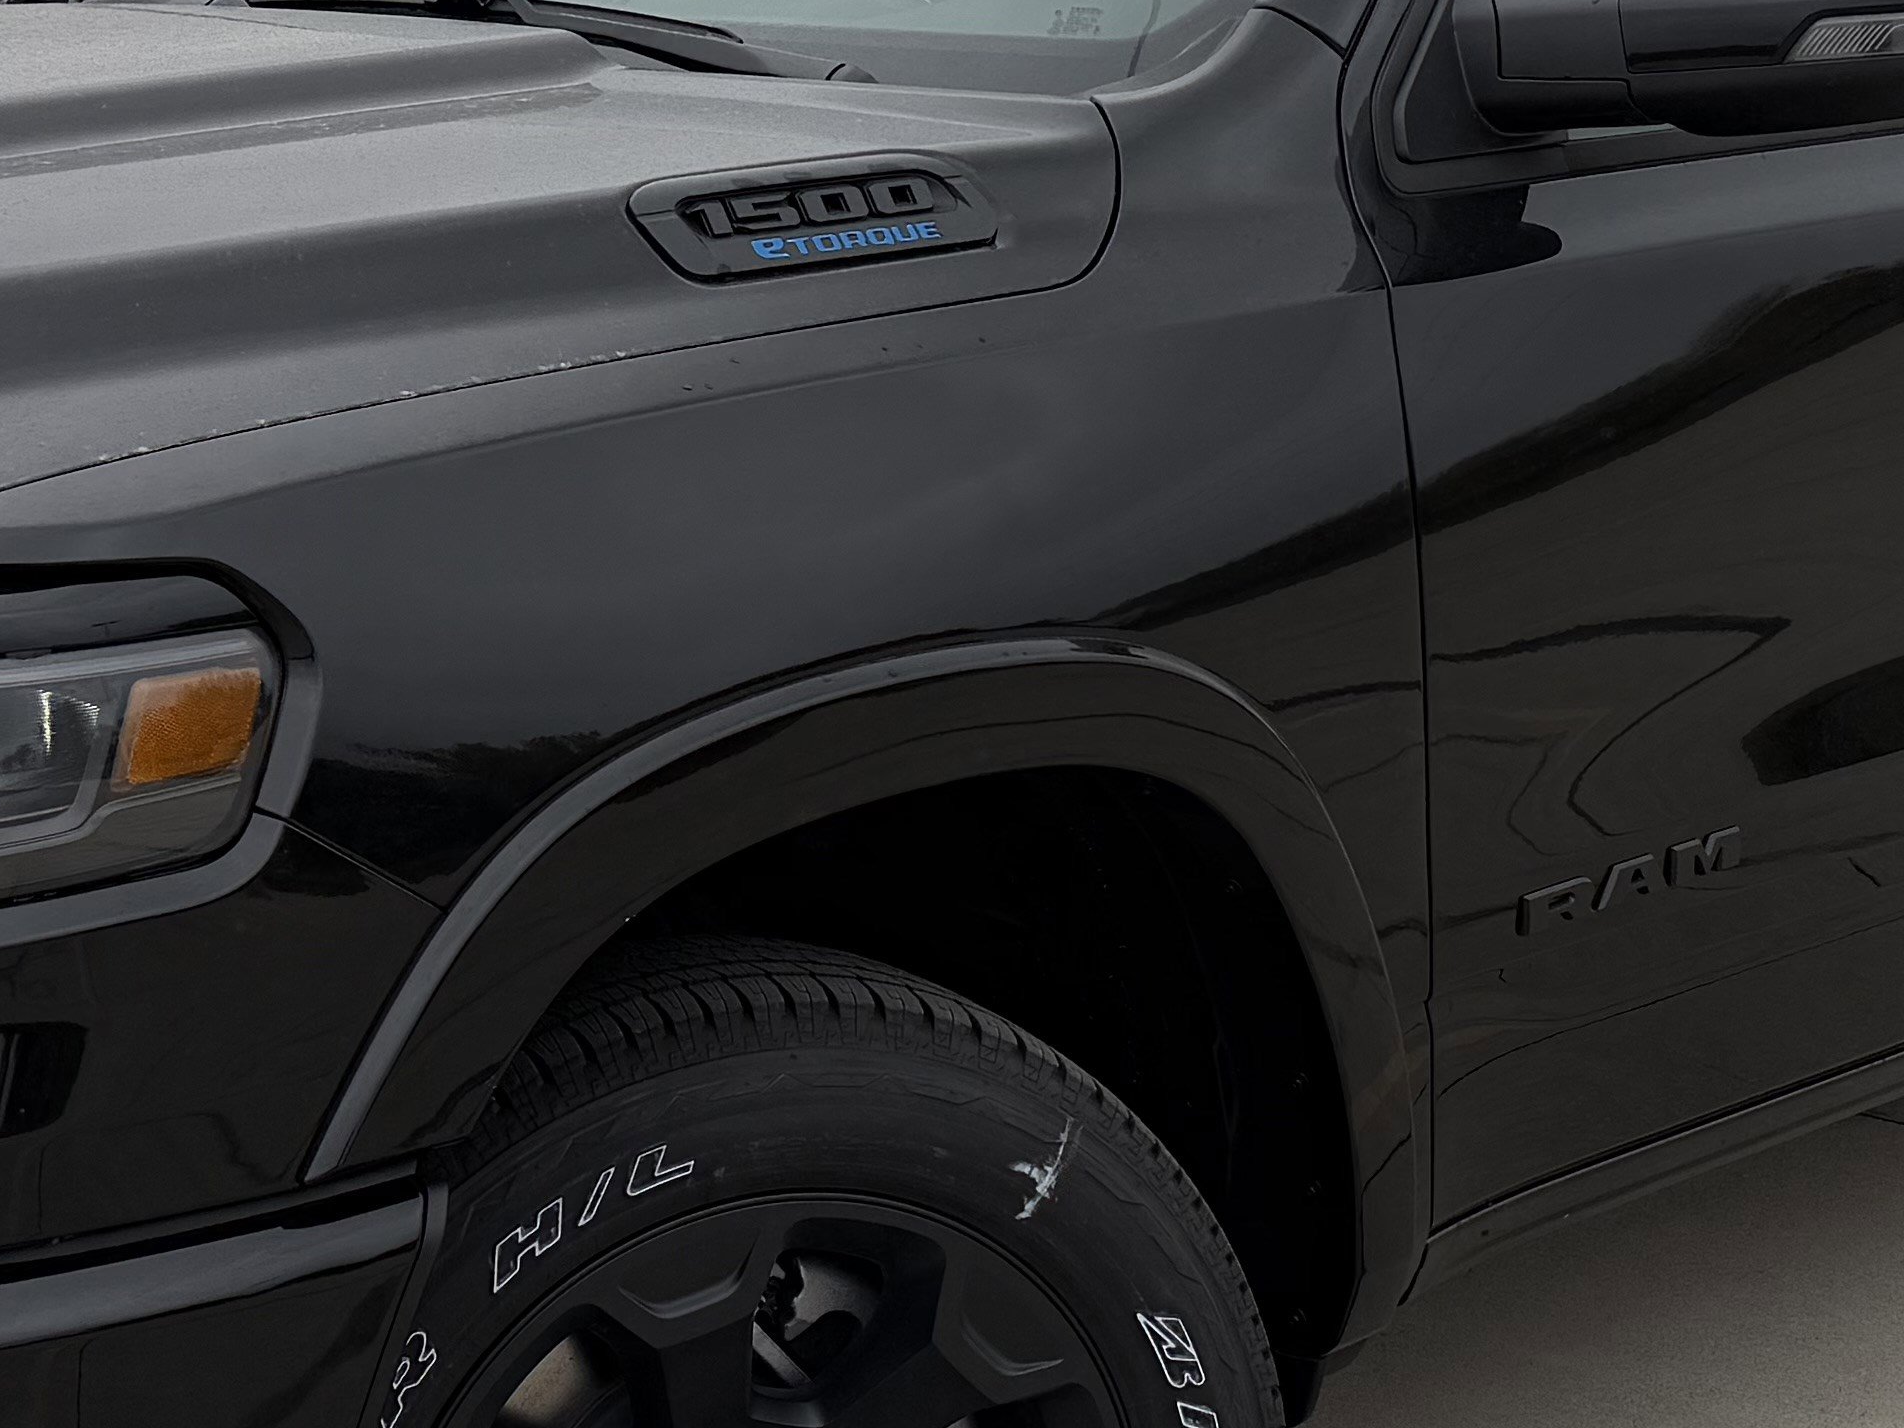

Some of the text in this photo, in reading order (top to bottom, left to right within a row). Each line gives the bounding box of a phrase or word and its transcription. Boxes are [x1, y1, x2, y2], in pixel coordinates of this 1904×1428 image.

[684, 176, 934, 239] 1500
[1514, 824, 1741, 937] RAM
[493, 1143, 695, 1294] H/L
